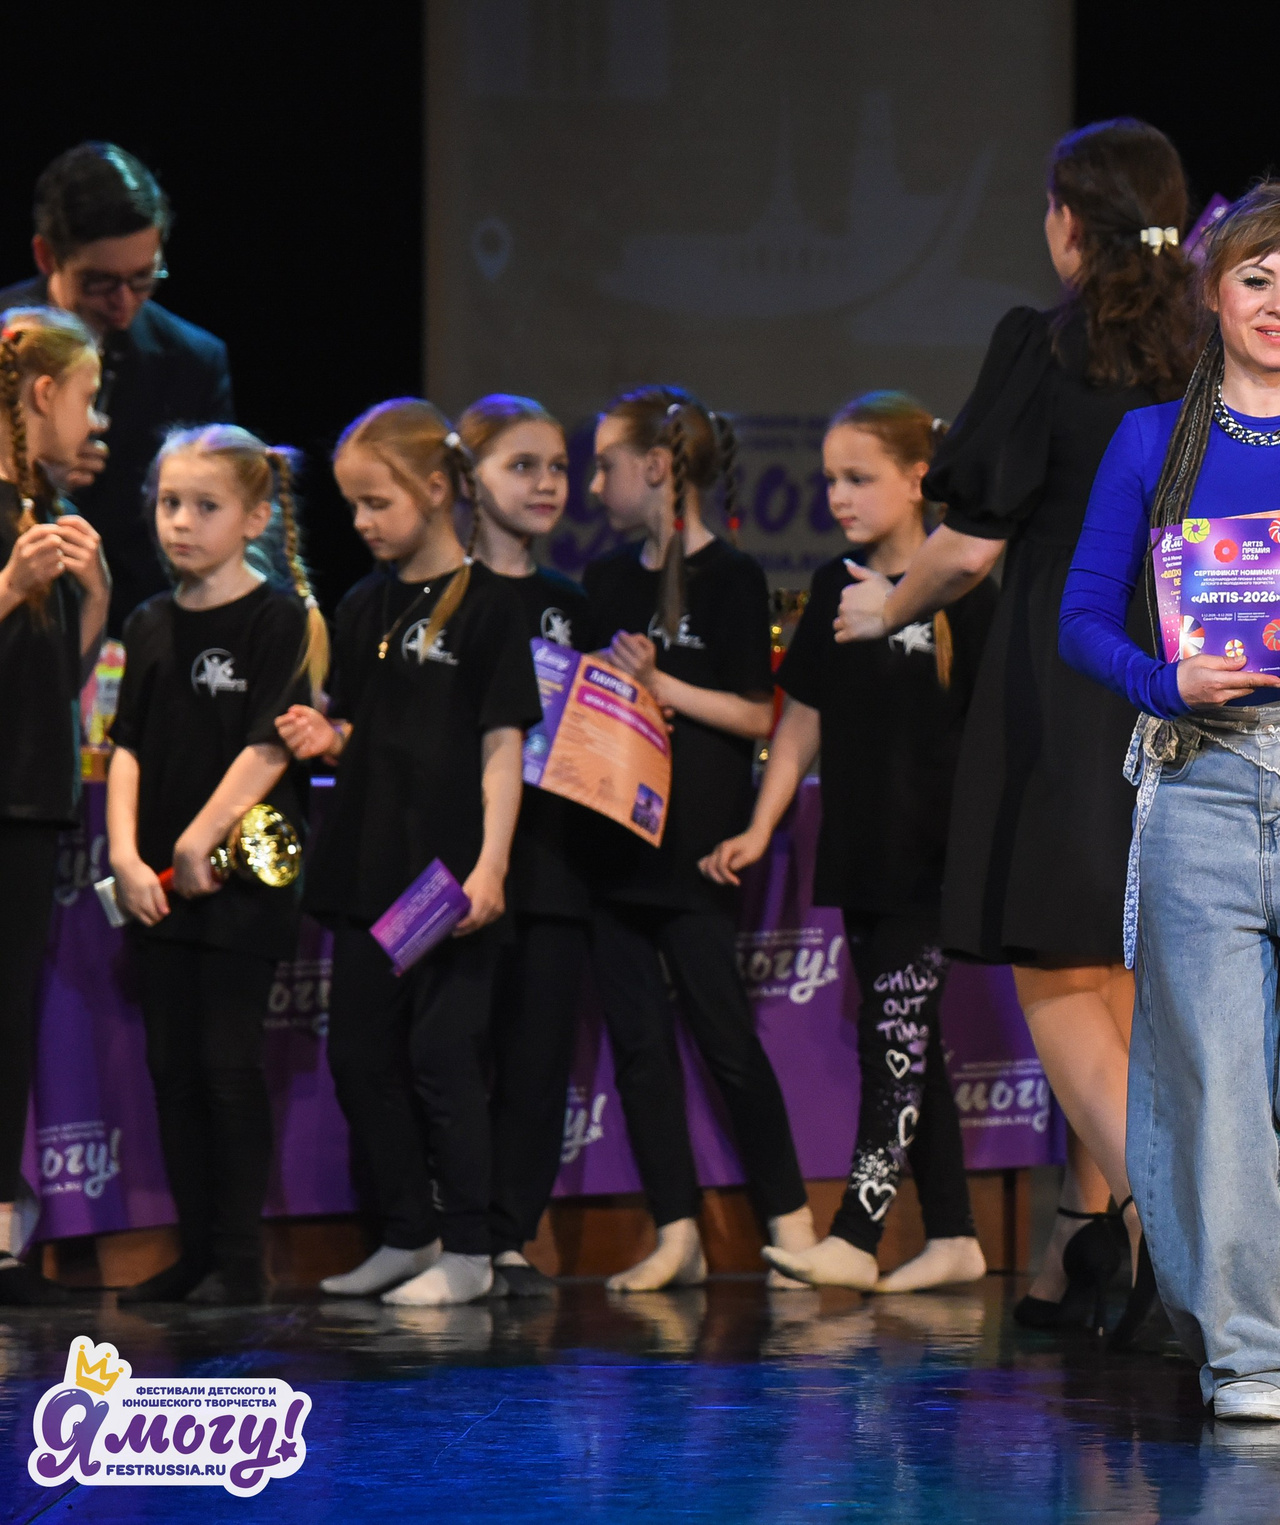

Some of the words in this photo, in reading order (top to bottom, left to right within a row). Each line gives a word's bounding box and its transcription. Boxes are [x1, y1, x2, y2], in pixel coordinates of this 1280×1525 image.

[1242, 540, 1264, 548] ARTIS
[1193, 569, 1239, 577] СЕРТИФИКАТ
[736, 934, 843, 1004] огу!
[883, 995, 928, 1016] OUT
[41, 1127, 121, 1199] огу!
